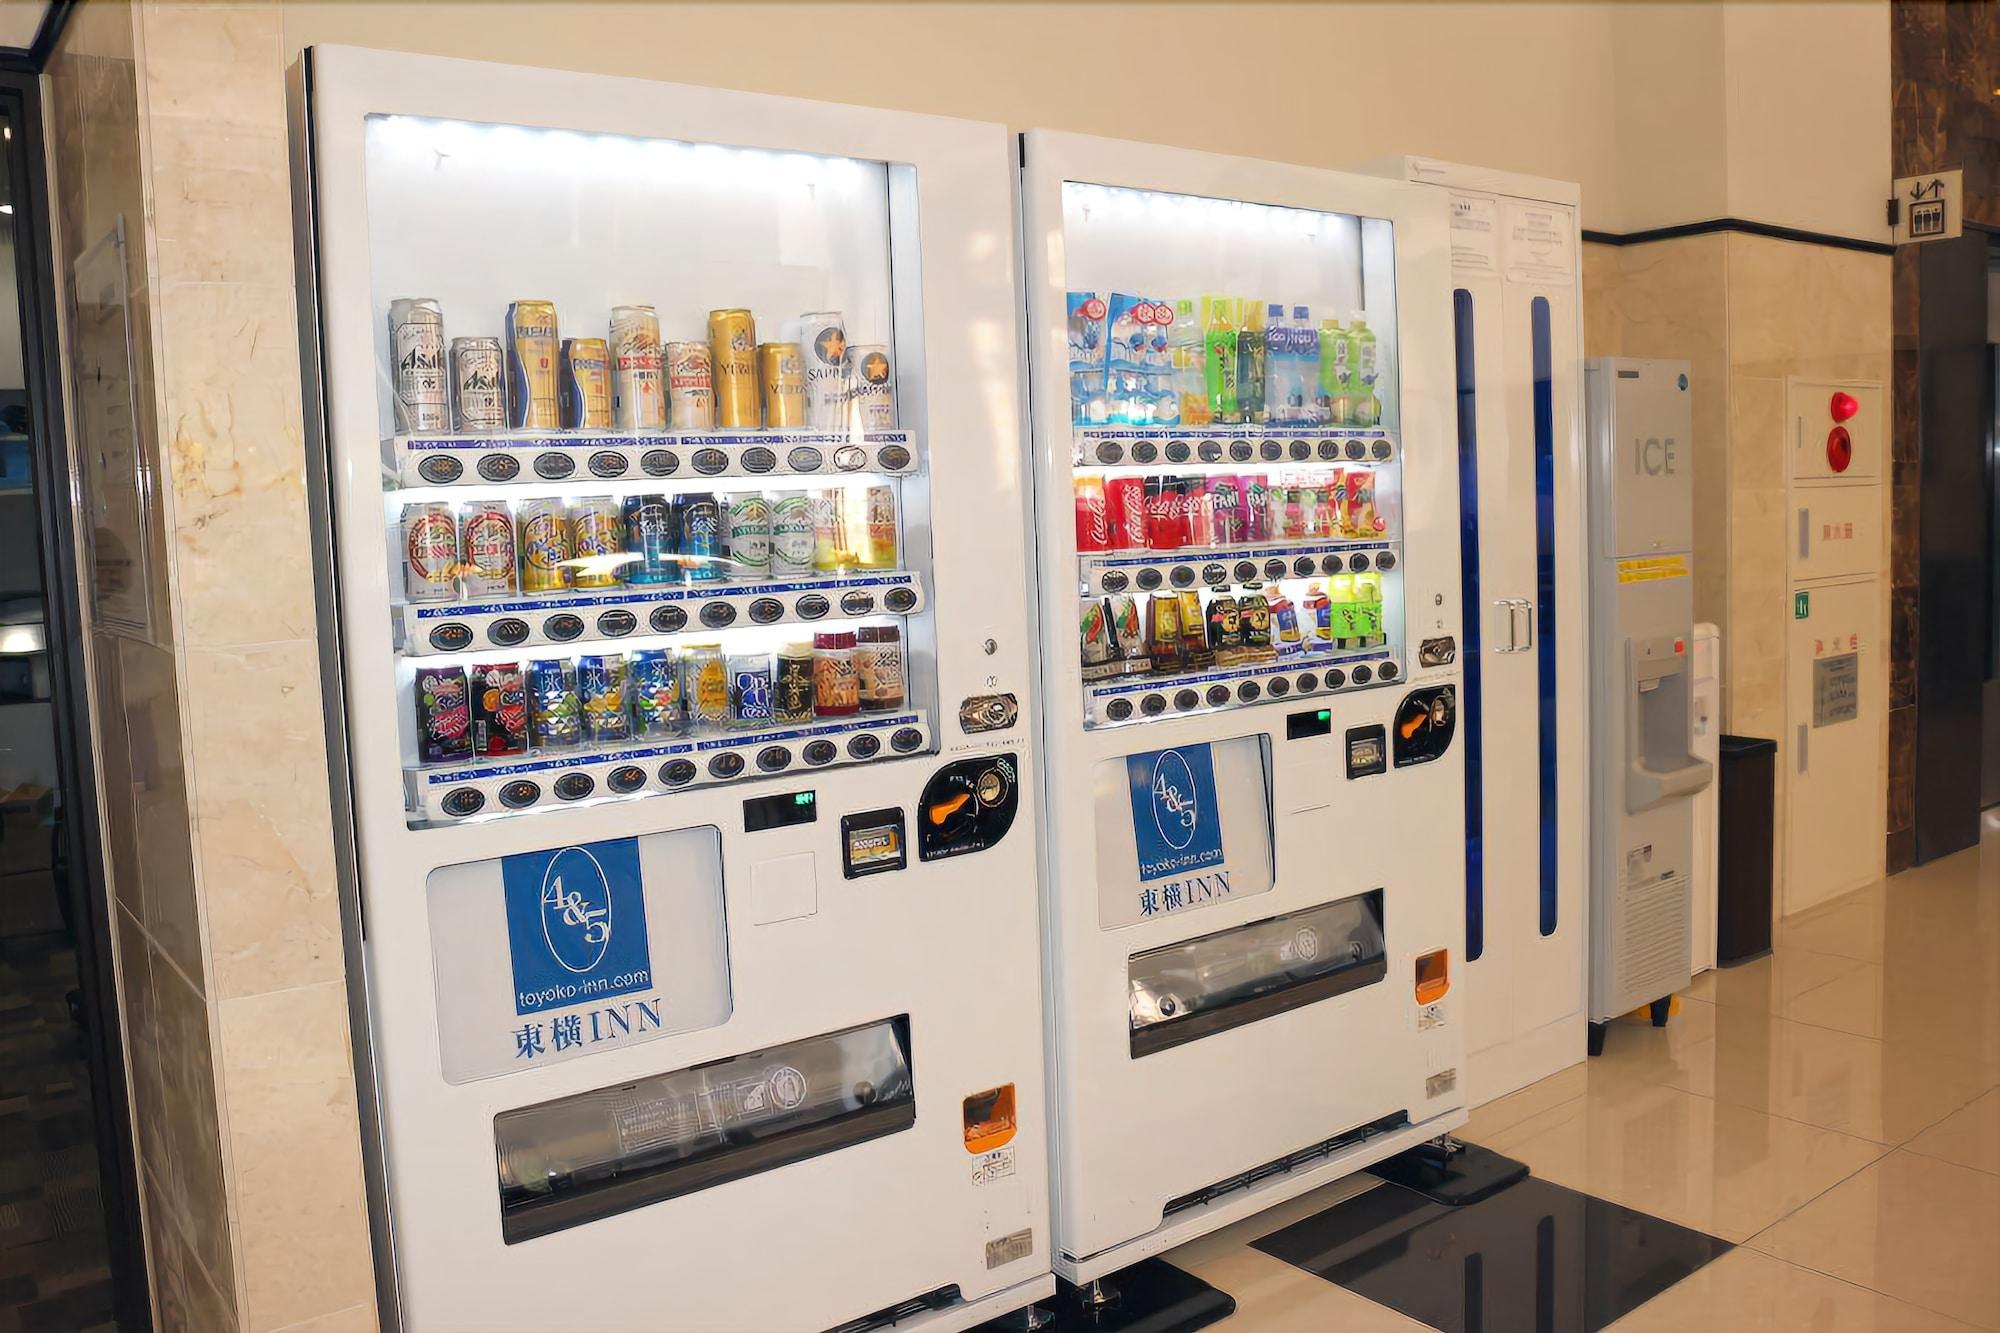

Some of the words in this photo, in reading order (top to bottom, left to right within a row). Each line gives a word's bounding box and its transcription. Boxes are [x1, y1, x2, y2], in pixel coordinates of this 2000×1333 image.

[1634, 438, 1676, 477] ICE
[544, 875, 611, 944] 4&5
[518, 969, 650, 1008] toyoko-inn.com
